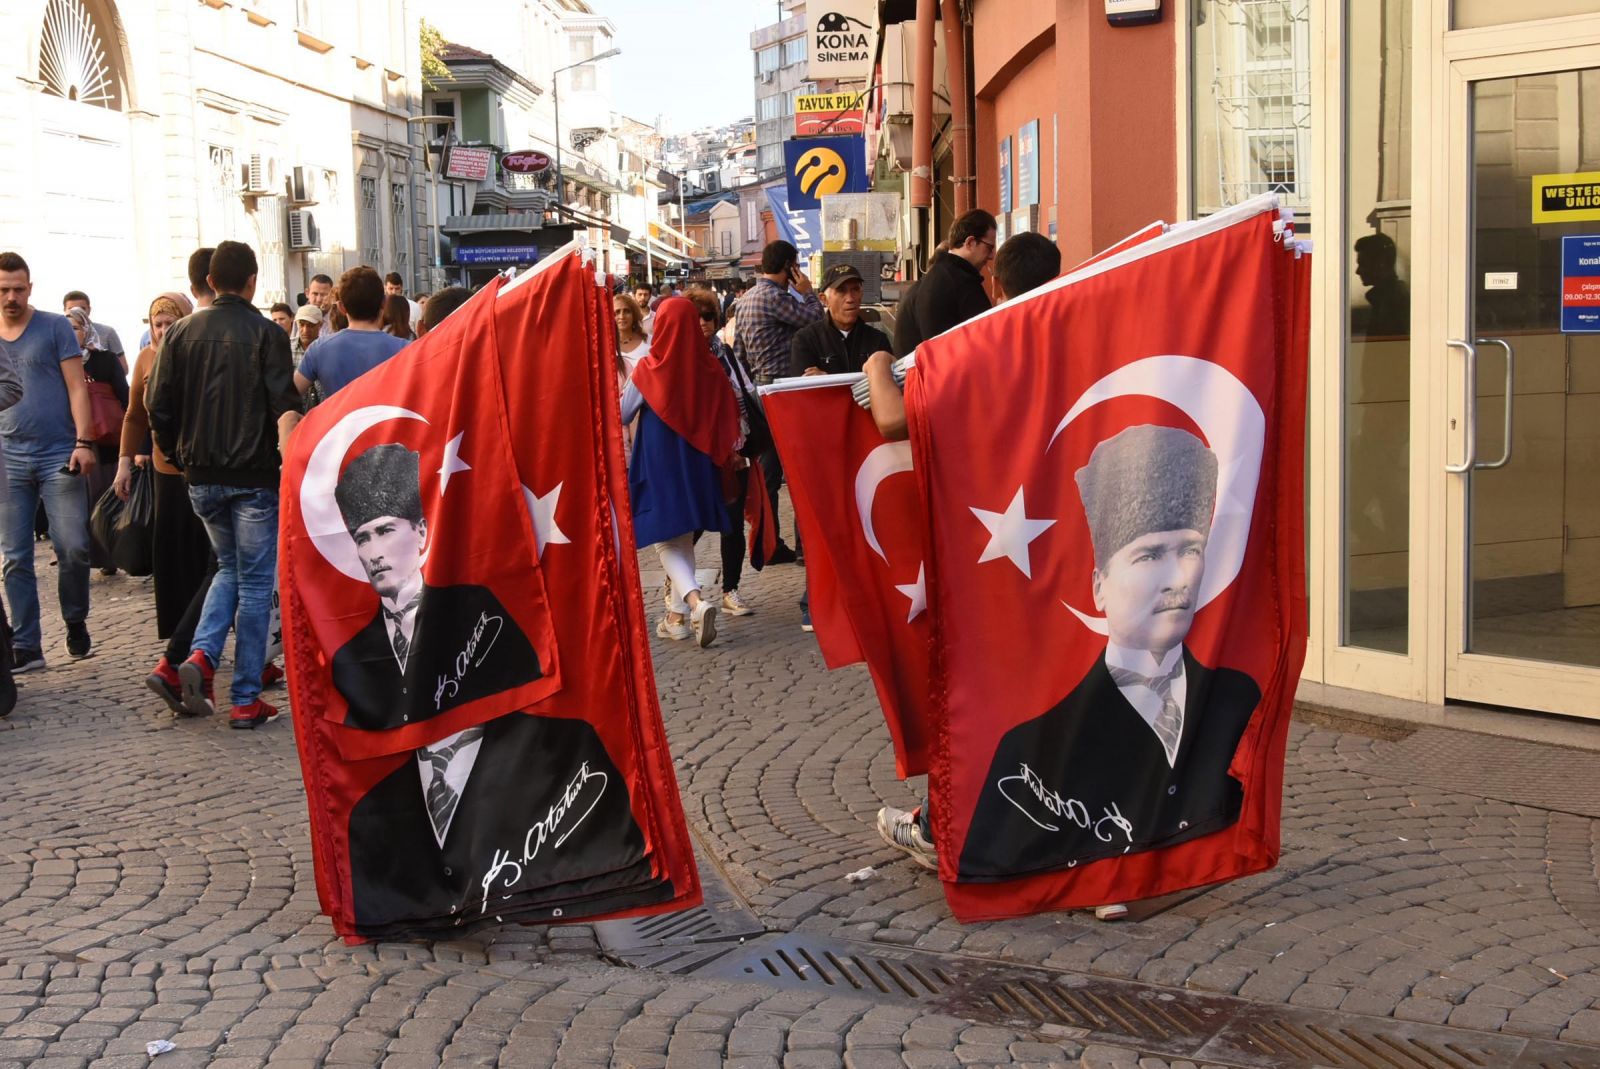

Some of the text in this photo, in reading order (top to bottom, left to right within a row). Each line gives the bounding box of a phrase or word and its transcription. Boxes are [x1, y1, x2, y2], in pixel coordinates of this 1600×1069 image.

[816, 33, 869, 49] KONA
[817, 51, 869, 63] SİNEMA
[798, 96, 834, 111] TAVUK
[1545, 186, 1600, 198] WESTER
